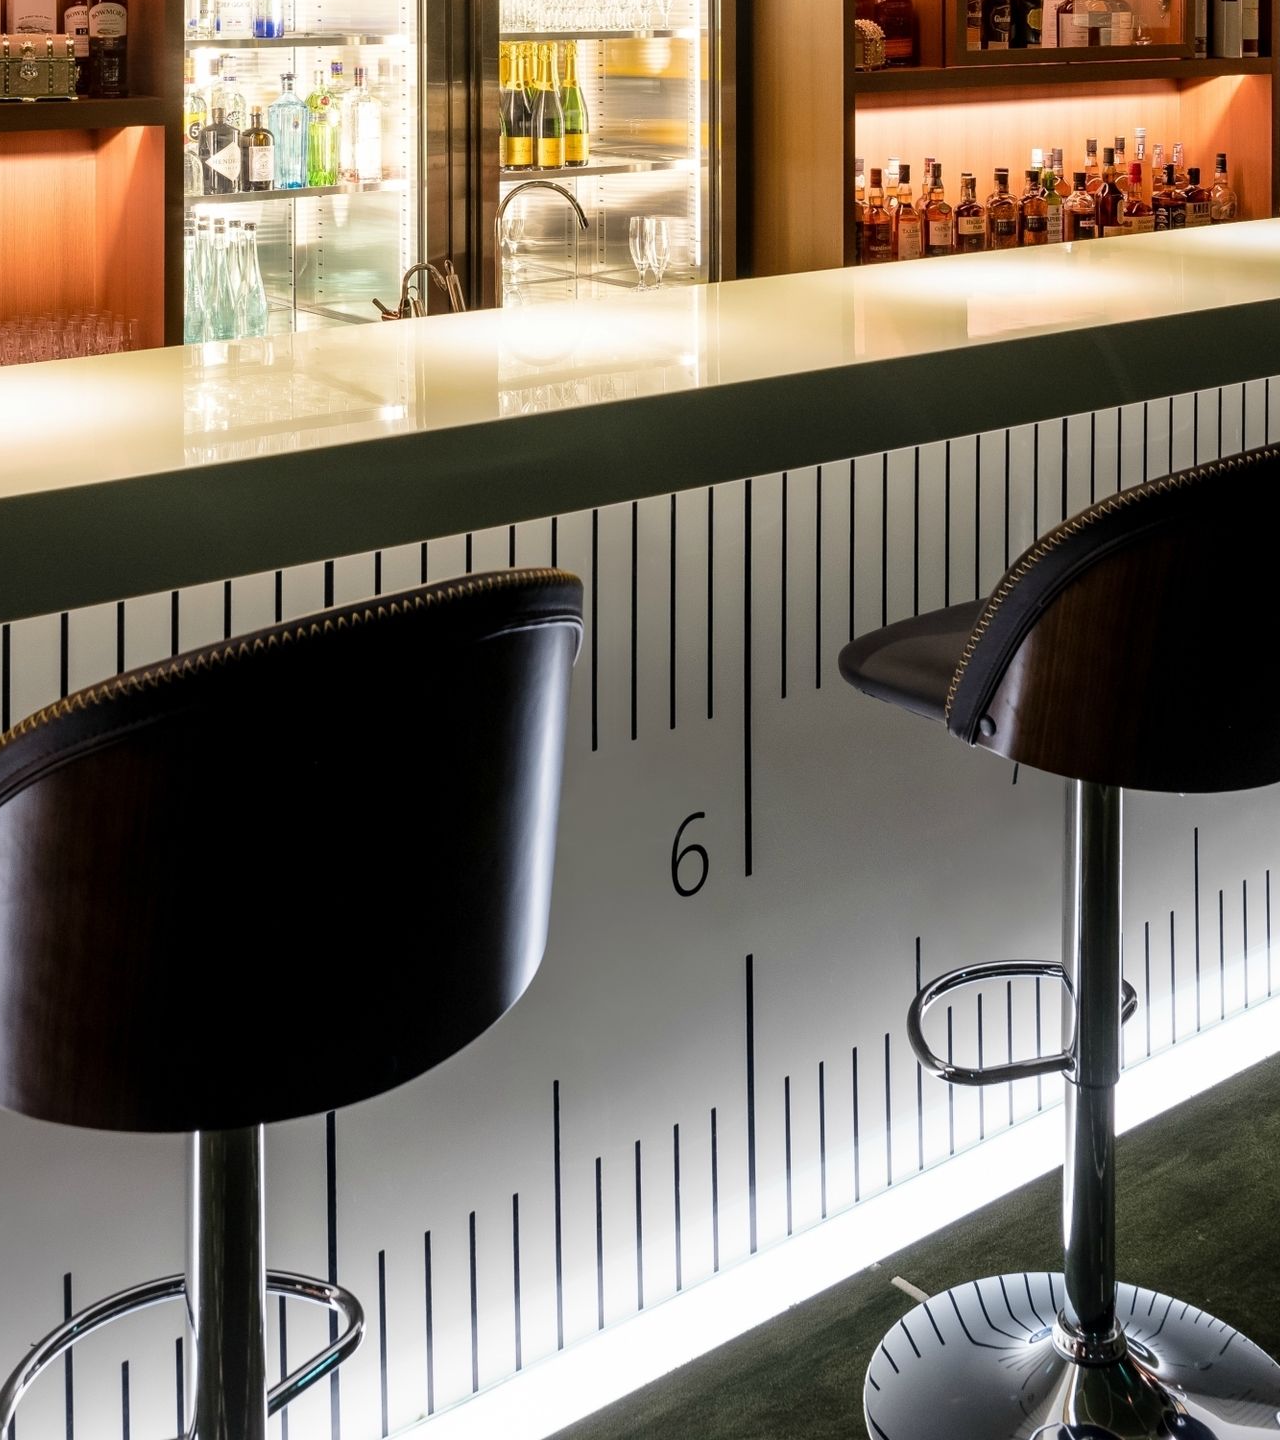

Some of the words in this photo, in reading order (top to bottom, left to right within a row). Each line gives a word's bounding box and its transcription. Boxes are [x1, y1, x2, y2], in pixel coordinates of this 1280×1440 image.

[66, 10, 88, 19] BOWM
[91, 9, 124, 19] BOWMORE
[671, 811, 709, 897] 6
